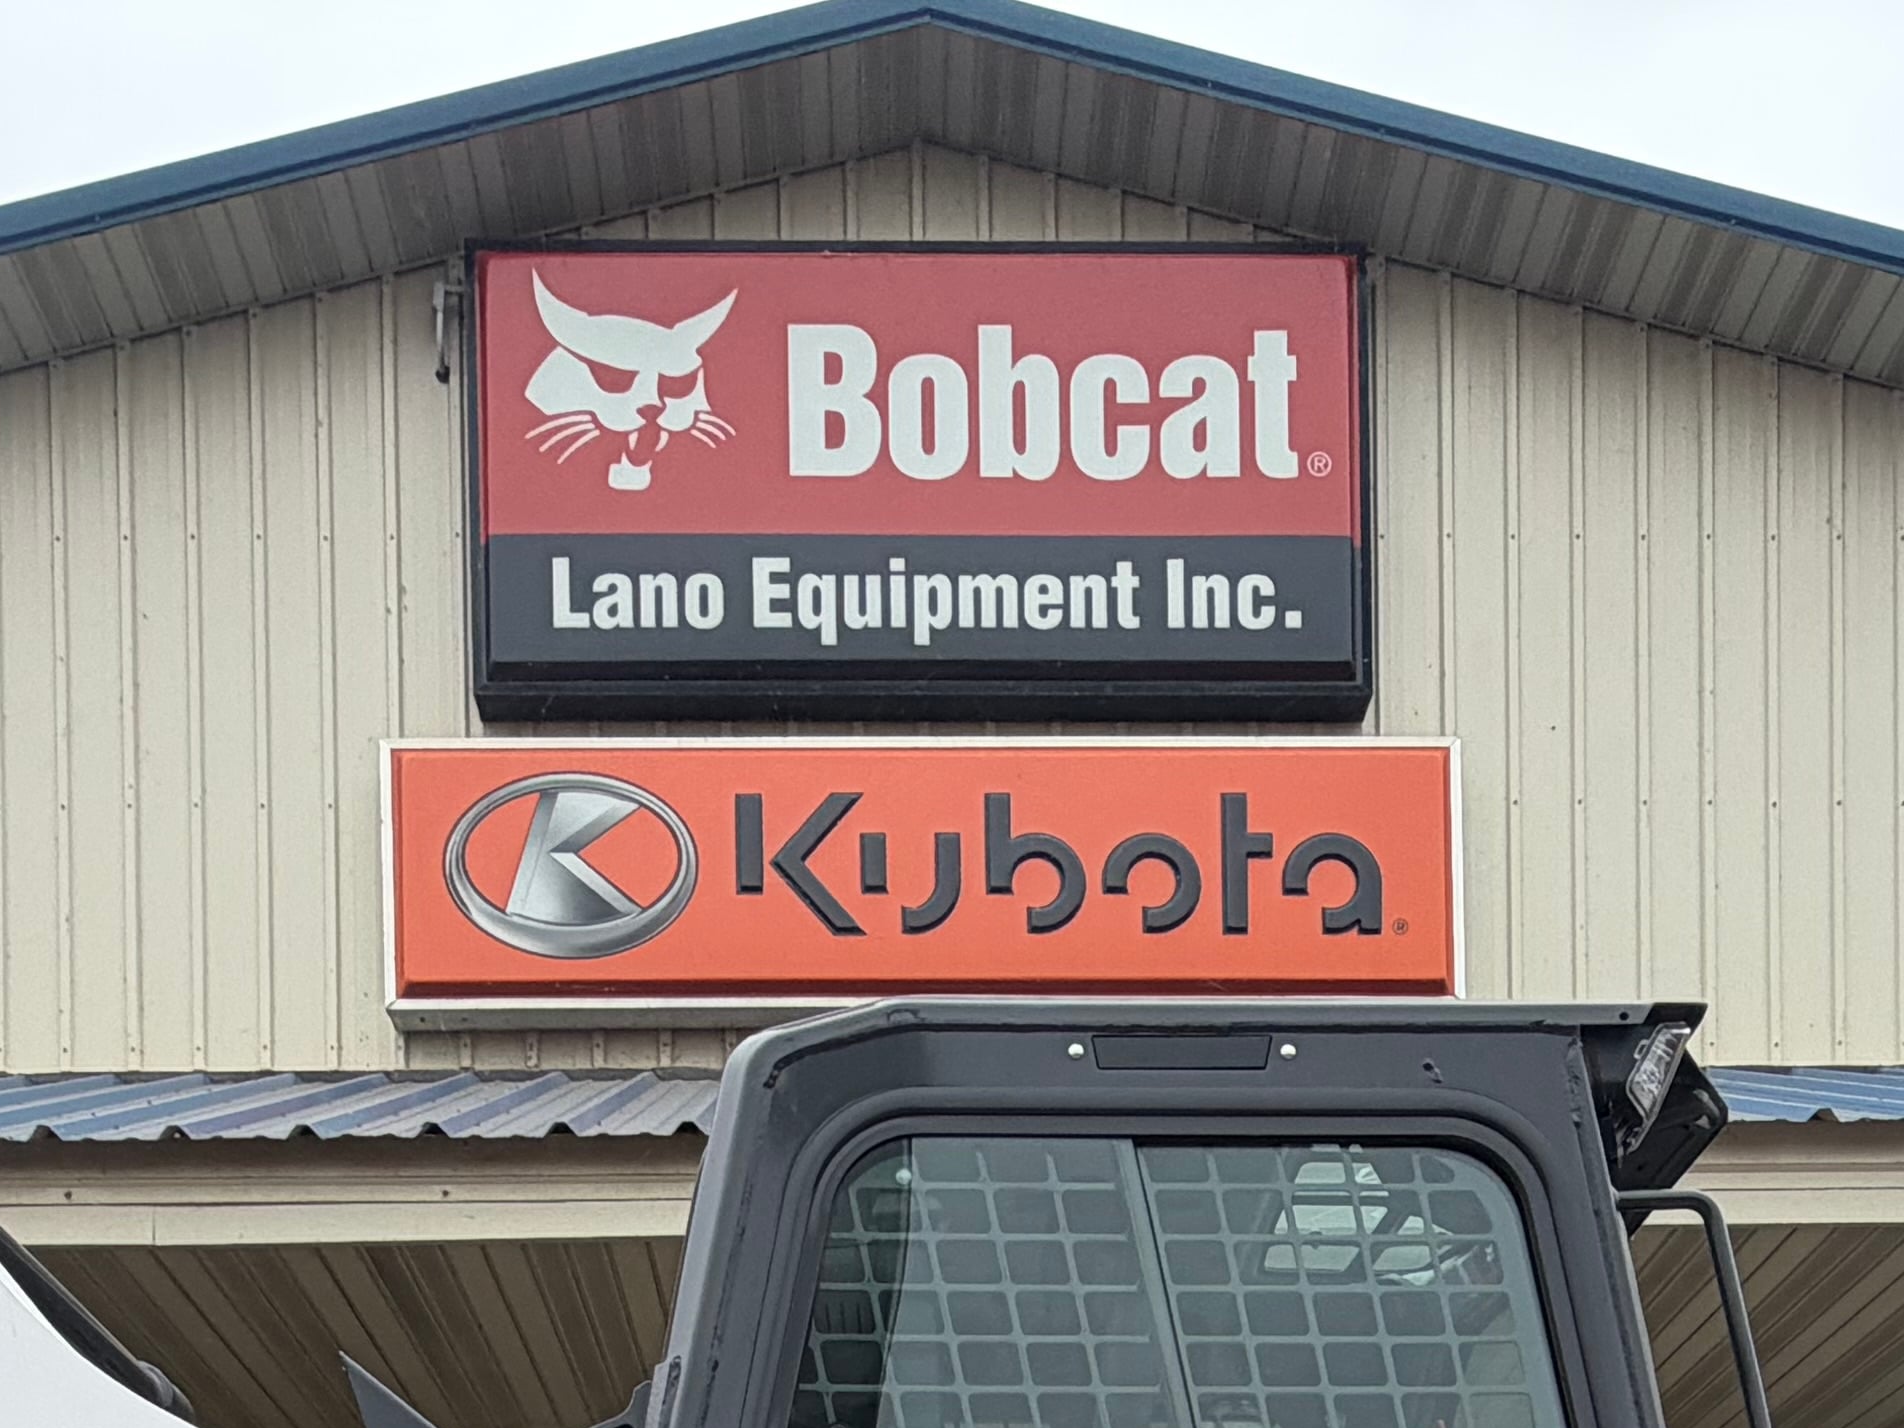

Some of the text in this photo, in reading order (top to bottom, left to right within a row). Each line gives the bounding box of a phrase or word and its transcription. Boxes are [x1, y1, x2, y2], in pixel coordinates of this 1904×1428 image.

[787, 323, 1299, 481] Bobcat
[550, 555, 1303, 647] Lano Equipment Inc.
[734, 791, 1384, 938] Kubota
